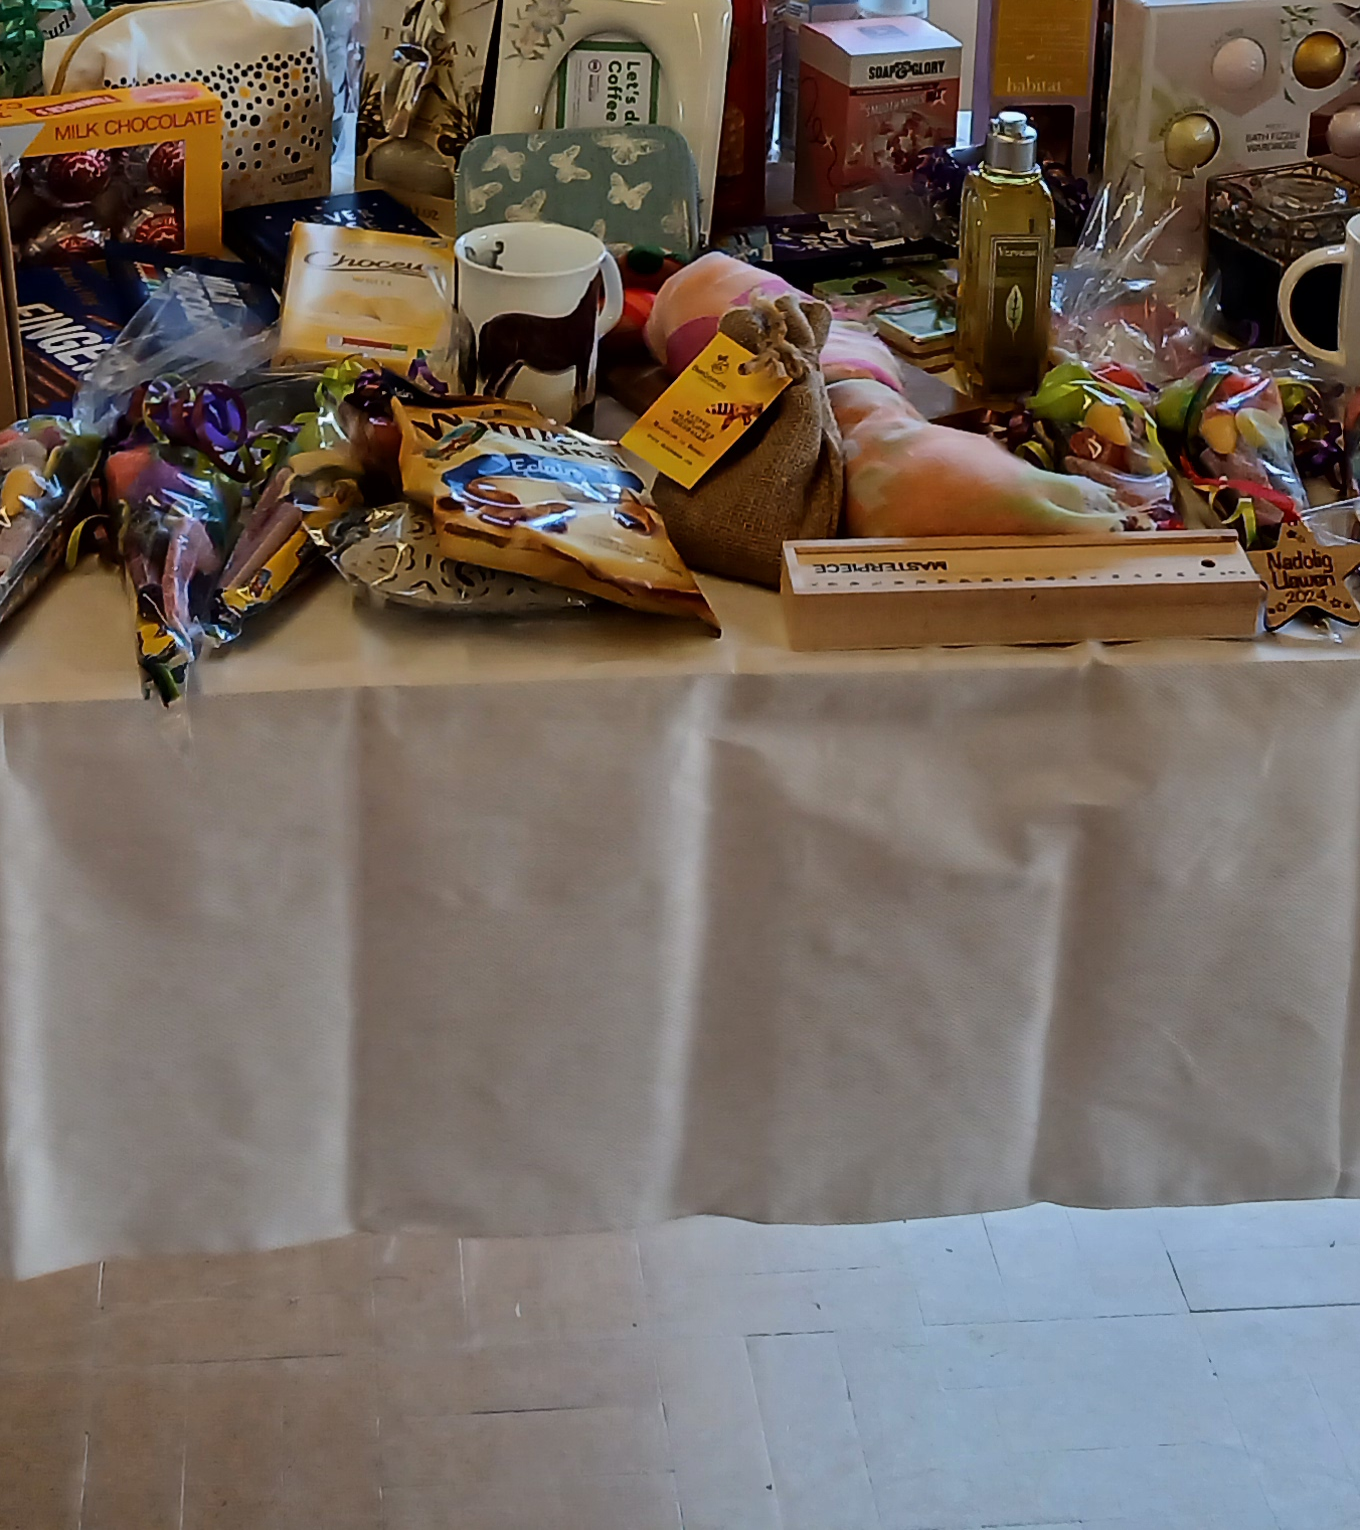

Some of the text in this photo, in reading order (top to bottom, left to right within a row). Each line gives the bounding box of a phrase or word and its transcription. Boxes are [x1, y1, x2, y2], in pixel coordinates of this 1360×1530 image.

[606, 60, 623, 122] Coffee
[625, 61, 641, 105] Let's
[1007, 76, 1062, 93] habitat
[55, 109, 217, 141] MILK CHOCOLATE
[813, 560, 948, 574] MASTERPIECE
[1266, 548, 1334, 574] Nadolig
[1285, 588, 1328, 604] 2024
